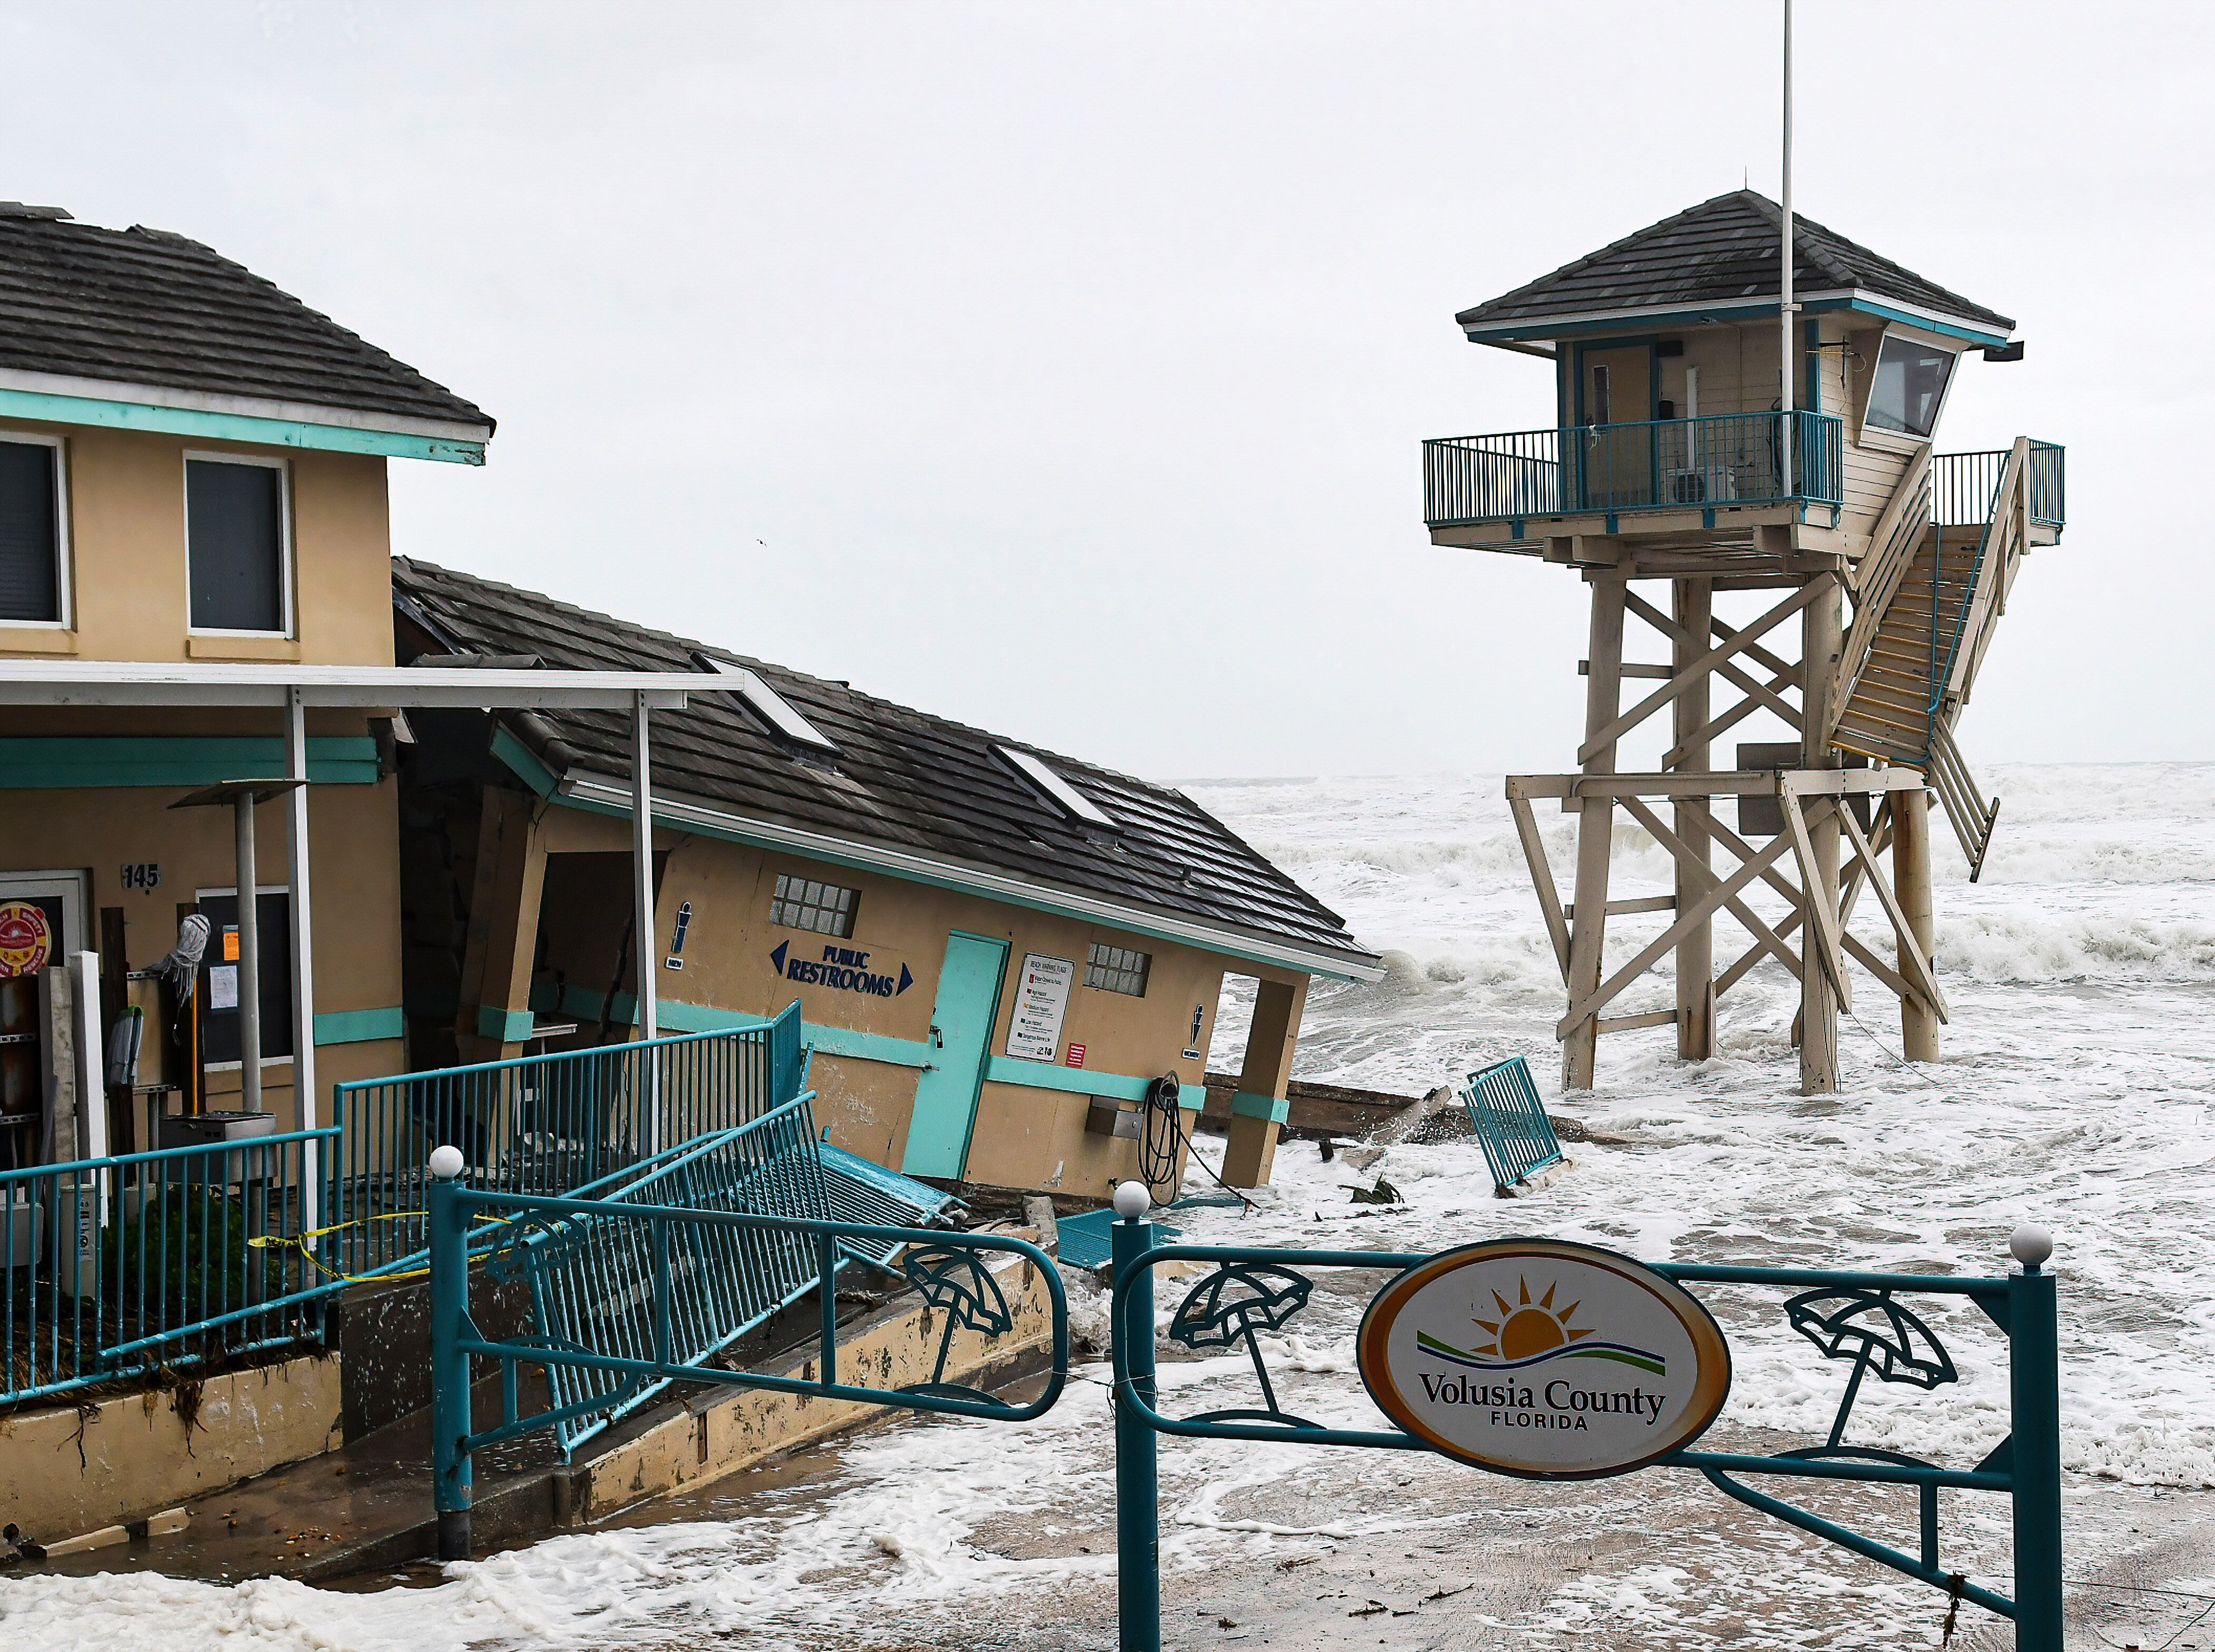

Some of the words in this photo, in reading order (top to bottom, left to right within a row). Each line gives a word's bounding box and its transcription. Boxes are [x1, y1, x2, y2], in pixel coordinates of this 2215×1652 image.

[125, 863, 158, 888] 145
[822, 945, 871, 969] PUBLIC
[786, 958, 894, 998] RESTROOMS
[1418, 1373, 1535, 1409] Volusia
[1544, 1379, 1666, 1426] County
[1490, 1411, 1588, 1432] FLORIDA
